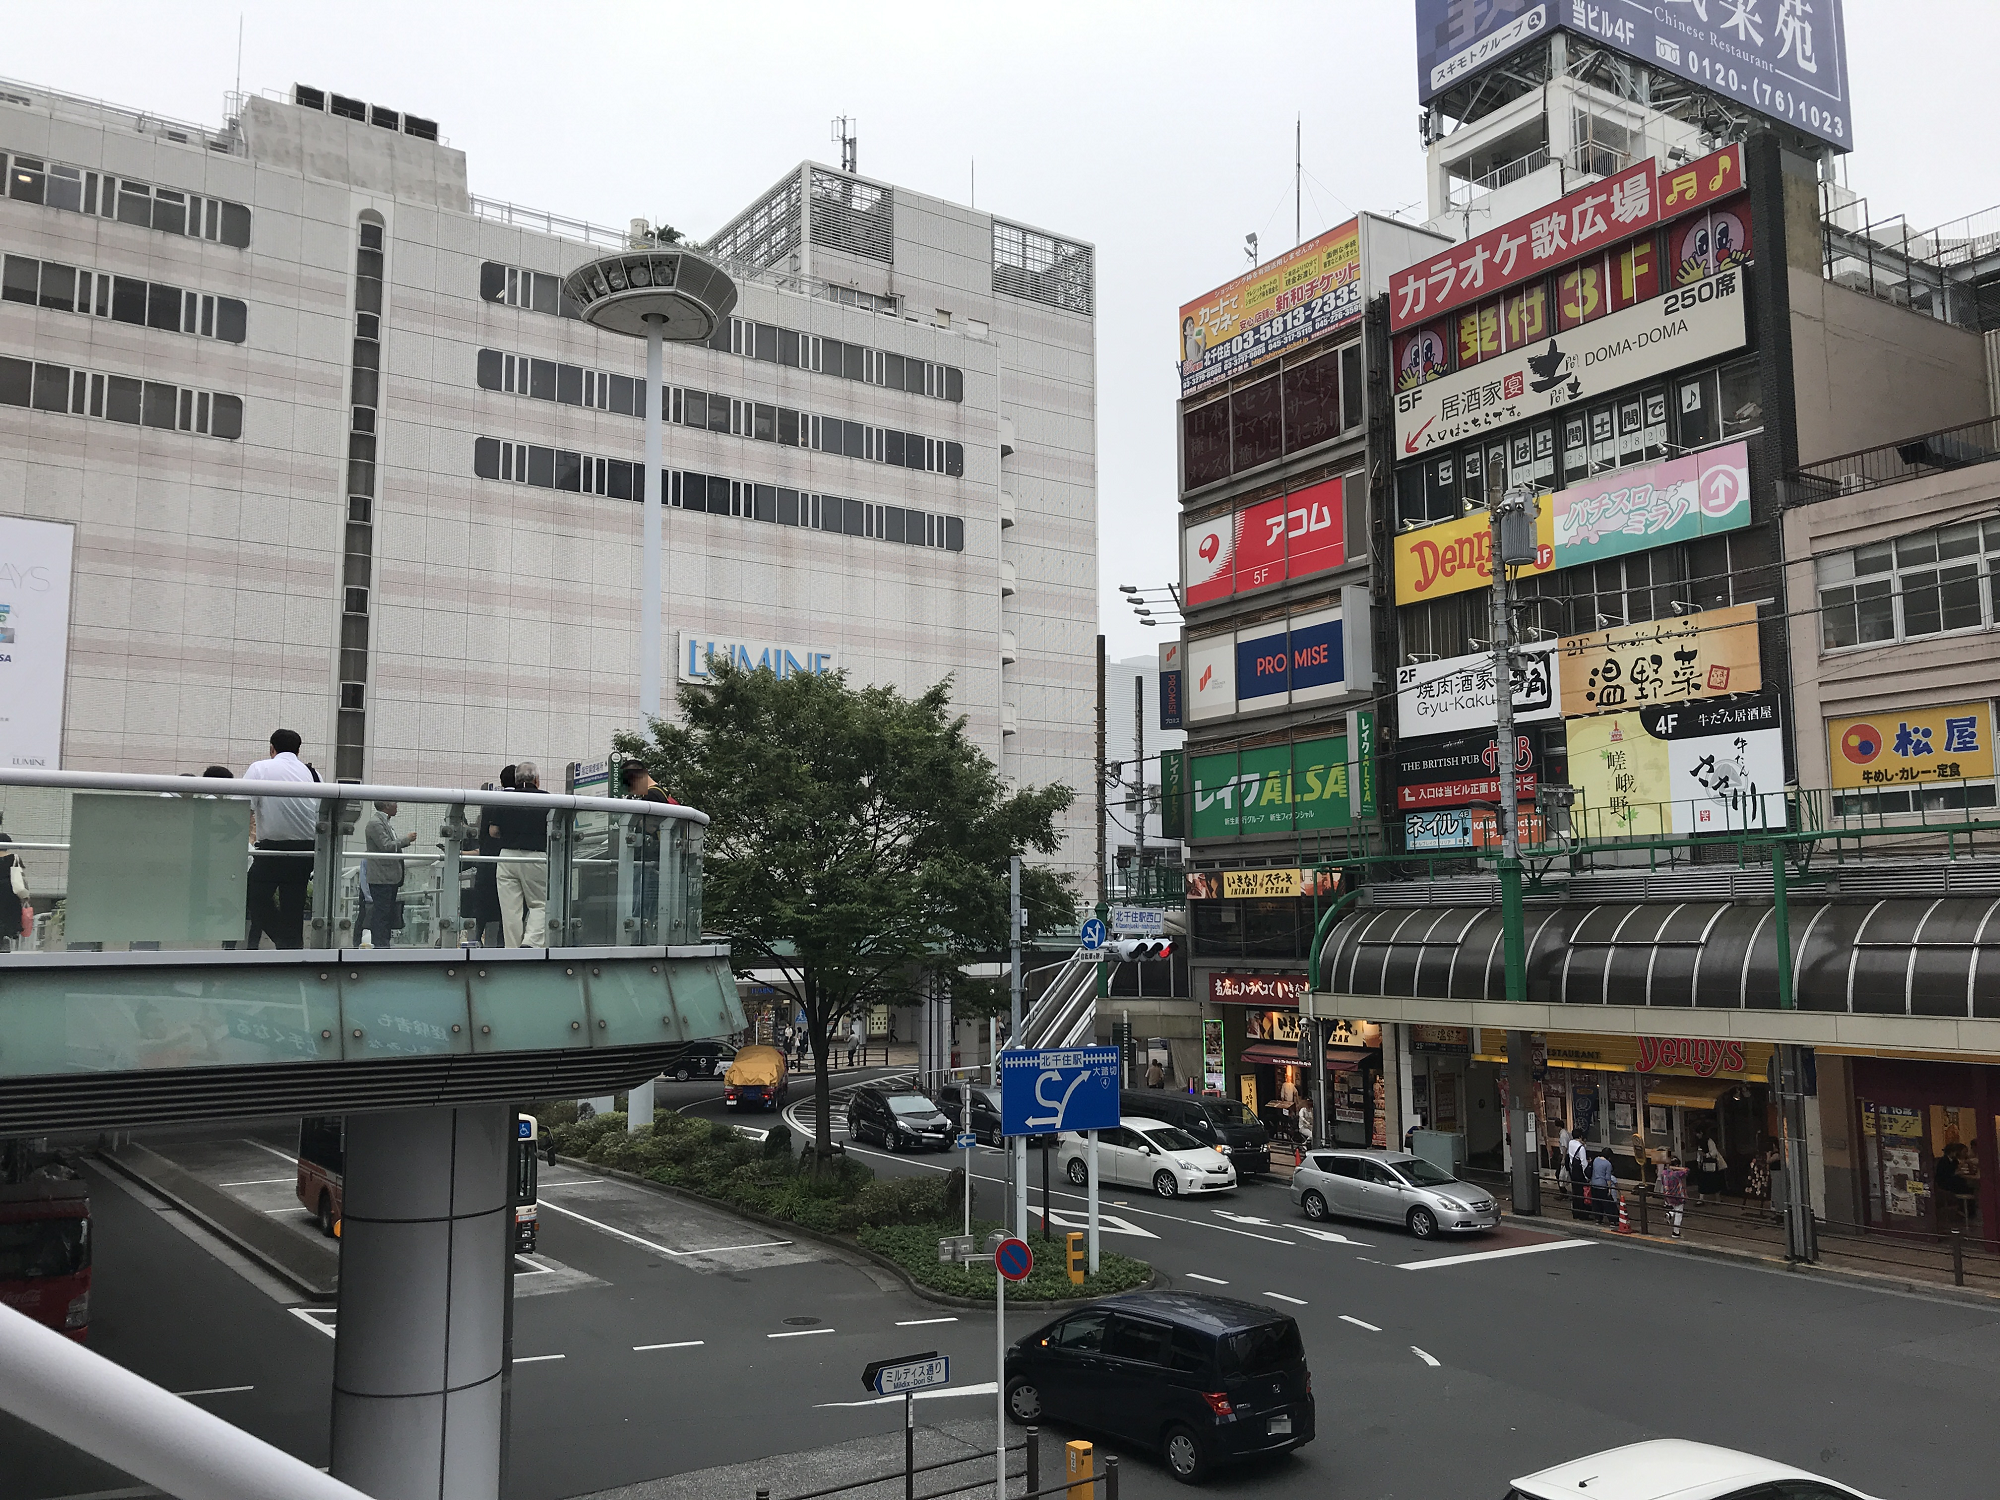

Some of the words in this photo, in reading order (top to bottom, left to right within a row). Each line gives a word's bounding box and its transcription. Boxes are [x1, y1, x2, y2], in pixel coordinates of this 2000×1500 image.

[1436, 21, 1524, 83] スギモトグループ
[1654, 6, 1705, 41] Chinese
[1710, 31, 1774, 73] Restaurant
[1688, 51, 1844, 138] 0120-(76)1023
[1398, 170, 1652, 320] カラオケ歌広場
[1664, 270, 1737, 317] 250席
[1198, 294, 1240, 326] カードで
[1203, 341, 1231, 367] 北千住店
[1231, 280, 1361, 355] 03-5813-2333
[1209, 313, 1240, 336] マネー
[1440, 380, 1503, 421] 居酒家
[1585, 318, 1689, 367] DOMA-DOMA
[1398, 389, 1423, 414] 5F
[1564, 484, 1652, 531] パチスロ
[1622, 499, 1690, 536] ミラノ
[1265, 502, 1332, 547] アコム
[1253, 568, 1269, 585] 5F
[1257, 643, 1328, 677] PROMISE
[1566, 637, 1591, 657] 2F
[1400, 668, 1417, 685] 2F
[1586, 644, 1703, 707] 温野菜
[1167, 674, 1177, 715] PROMISE
[1416, 692, 1497, 718] Gyu-Kaku
[1655, 713, 1679, 735] 4F
[1697, 705, 1773, 728] 牛たん居酒屋
[1892, 716, 1980, 757] 松屋
[1401, 761, 1421, 772] THE
[1422, 756, 1460, 770] BRITISH
[1461, 754, 1480, 766] PUB
[1418, 782, 1489, 799] 入口は当ビル正面
[1607, 750, 1638, 821] 嵯峨野
[1406, 813, 1459, 839] ネイル
[1230, 887, 1258, 896] IKINARI
[1264, 886, 1290, 895] STEAK
[1115, 911, 1162, 923] 北千住駅西口
[1041, 1053, 1083, 1067] 北千住駅
[1547, 1048, 1600, 1060] ESTAURANT
[1092, 1066, 1117, 1077] 大踏切
[1102, 1078, 1108, 1086] 4
[886, 1361, 942, 1383] ミルディス通り
[926, 1375, 935, 1383] St.
